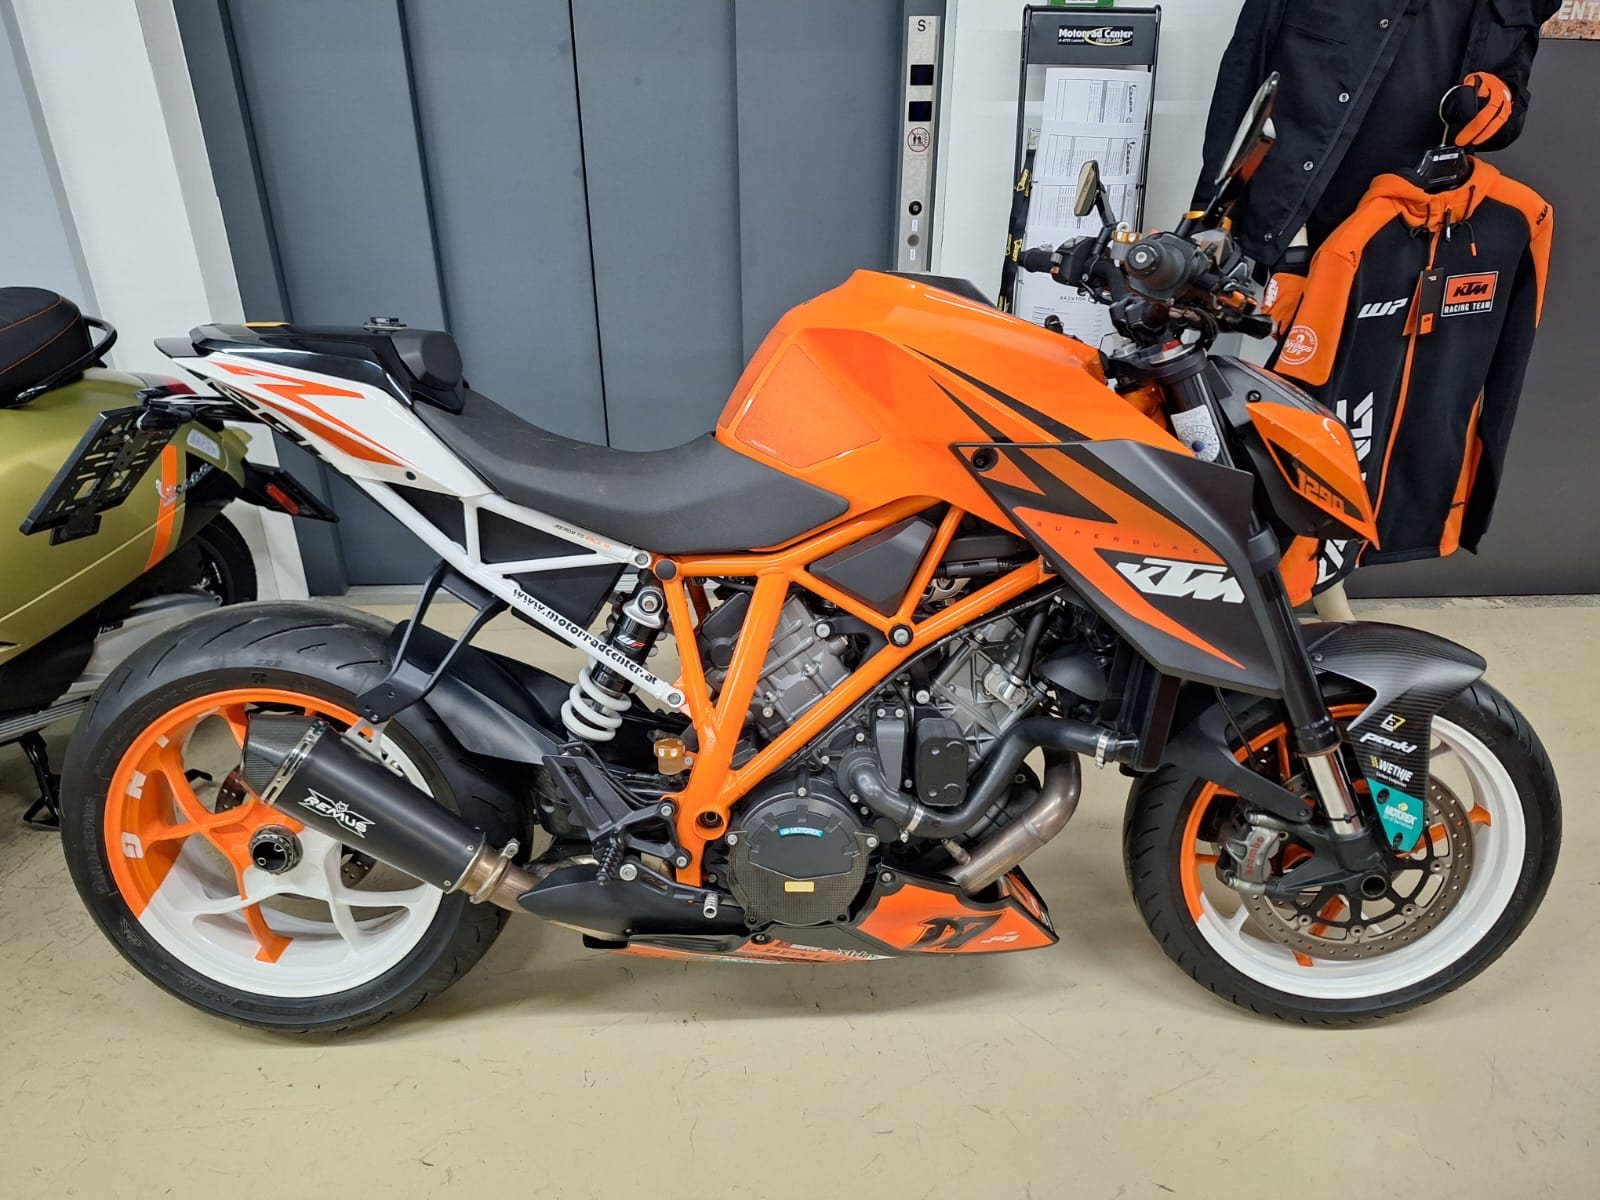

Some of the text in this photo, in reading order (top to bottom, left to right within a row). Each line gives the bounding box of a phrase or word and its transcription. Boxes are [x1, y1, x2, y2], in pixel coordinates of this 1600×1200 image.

[917, 20, 926, 32] S
[1058, 28, 1134, 38] Motorrad Center
[1453, 281, 1489, 298] KTM
[1444, 301, 1491, 314] RACING TEAM
[1296, 466, 1346, 515] 1290
[1115, 557, 1246, 604] KTM
[512, 588, 658, 685] www.motorradcenter.at
[303, 796, 367, 833] REMUS
